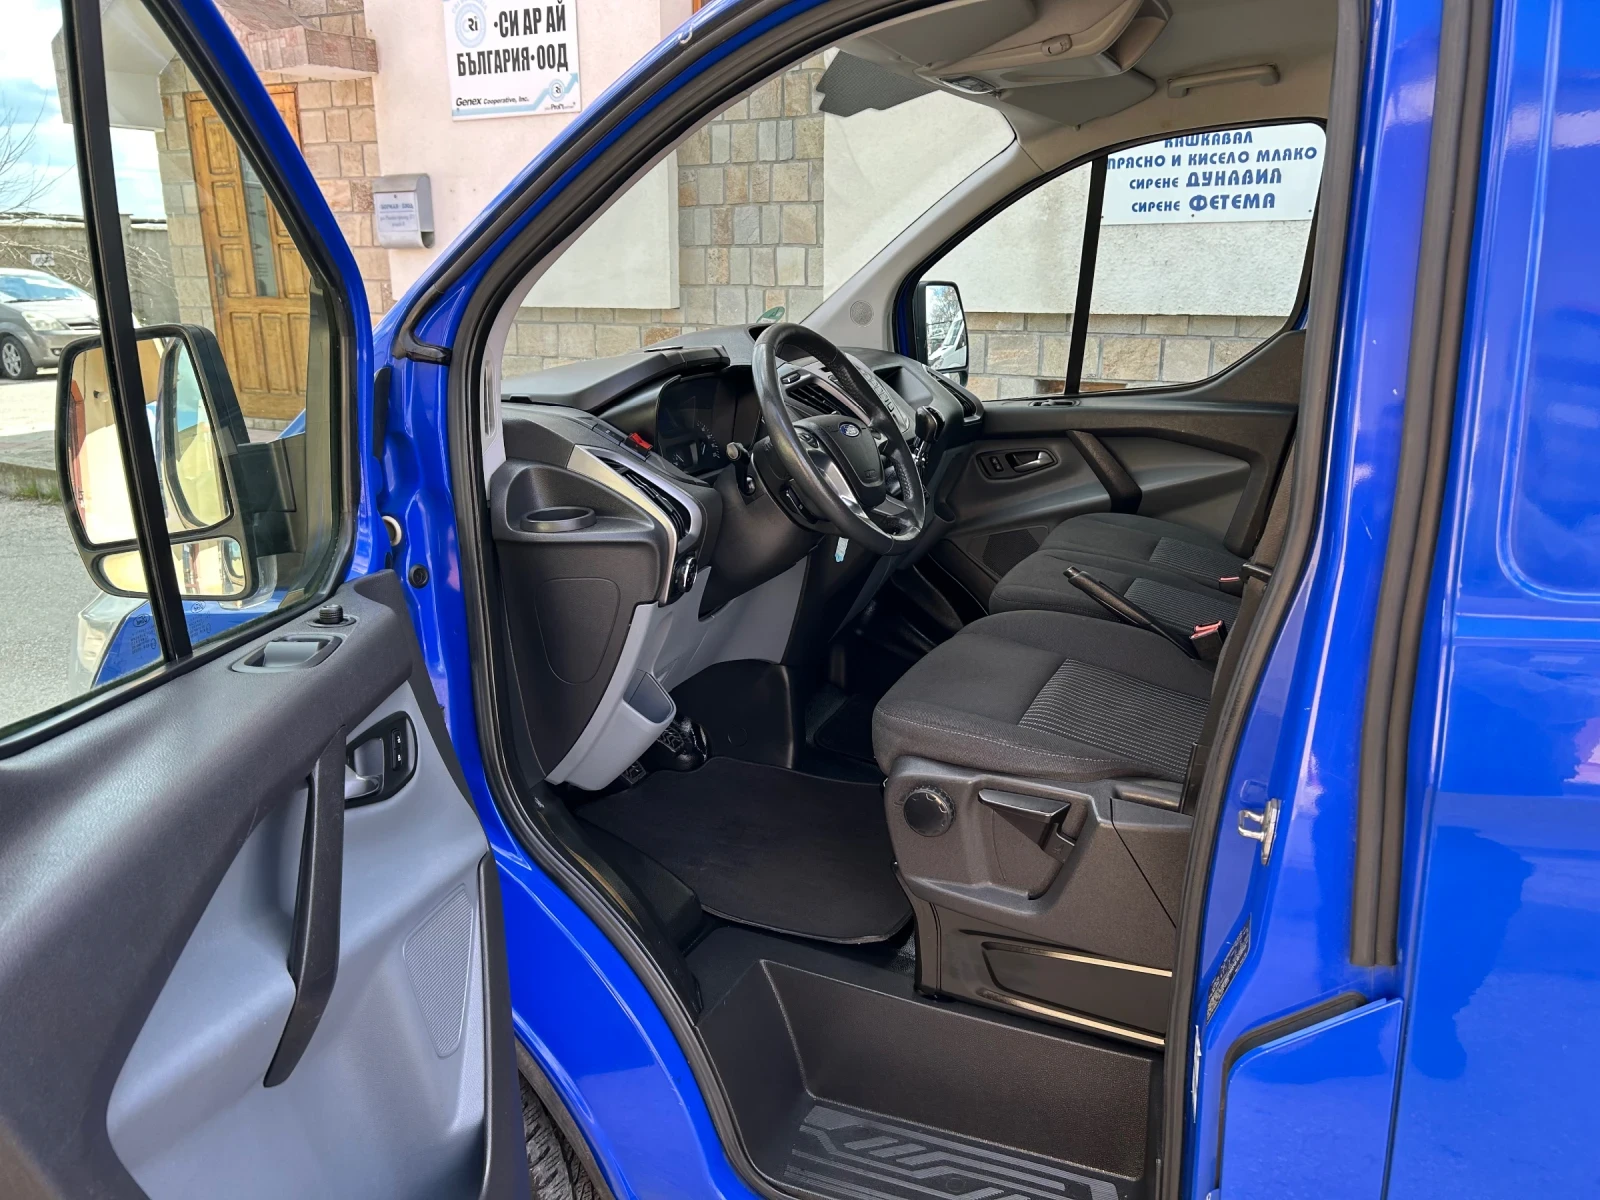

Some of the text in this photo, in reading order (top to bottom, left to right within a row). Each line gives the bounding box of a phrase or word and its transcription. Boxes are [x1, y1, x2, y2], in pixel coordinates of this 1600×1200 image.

[523, 8, 542, 36] АР
[546, 0, 567, 33] АЙ
[456, 97, 481, 107] Genex
[1164, 130, 1253, 148] КАШКАВАЛ
[1107, 146, 1317, 170] ПРЯСНО И КИСЕЛО МЛЯКО
[1129, 176, 1179, 190] СИРЕНЕ
[1131, 192, 1275, 213] СИРЕНЕ ФЕТЕМА
